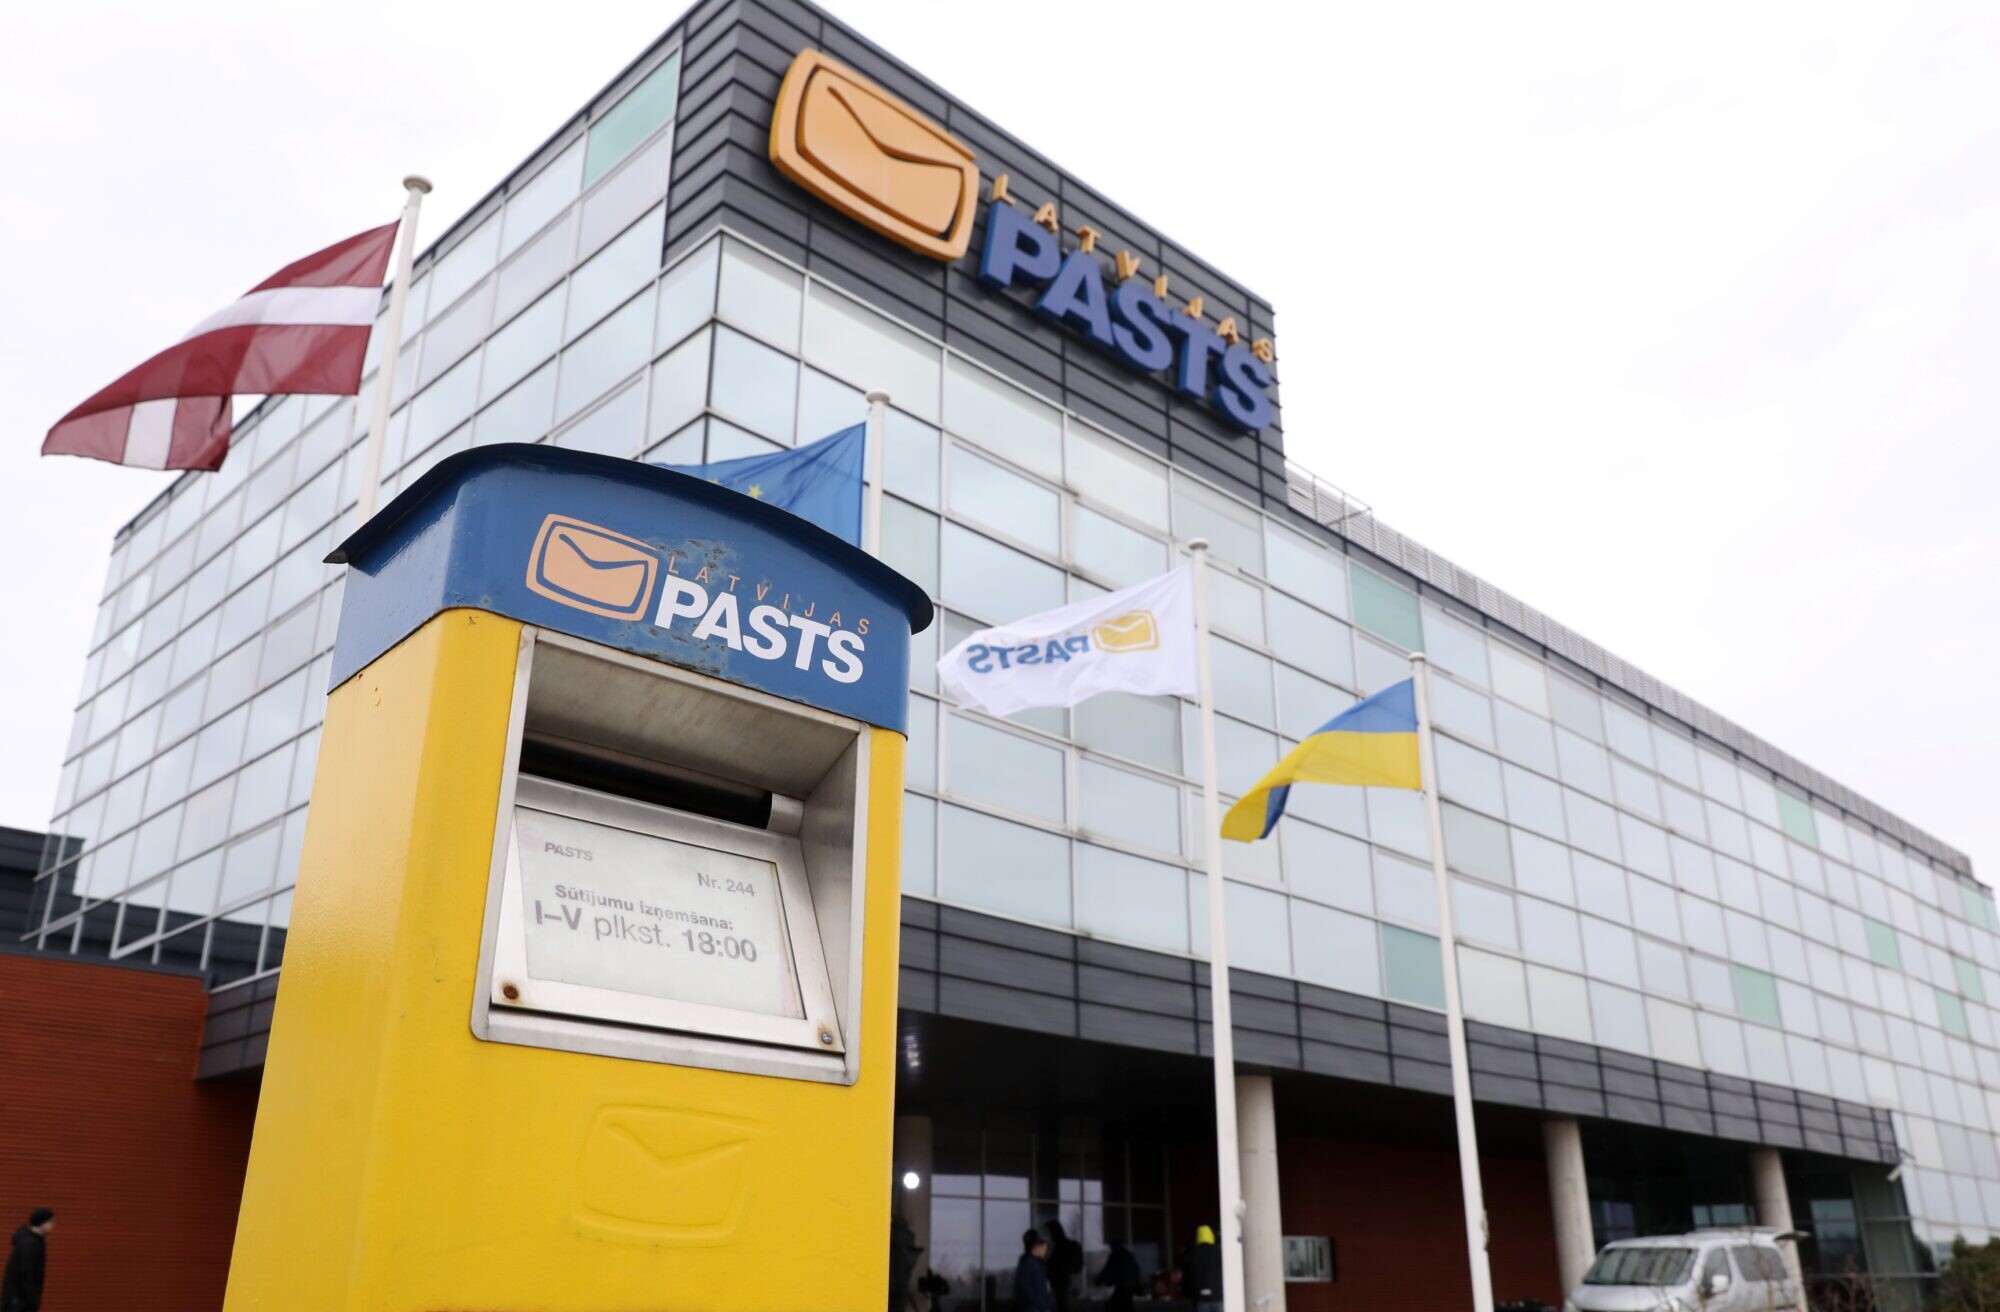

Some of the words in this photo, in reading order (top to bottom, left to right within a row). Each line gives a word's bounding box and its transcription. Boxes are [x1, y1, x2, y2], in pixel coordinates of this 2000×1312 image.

[993, 174, 1273, 362] LATVIJAS
[979, 200, 1272, 431] PASTS
[654, 574, 866, 684] PASTS
[668, 556, 869, 635] LATVIJAS
[544, 842, 593, 861] PASTS
[697, 872, 722, 891] Nr.
[725, 878, 756, 897] 244
[682, 929, 757, 962] 18:00
